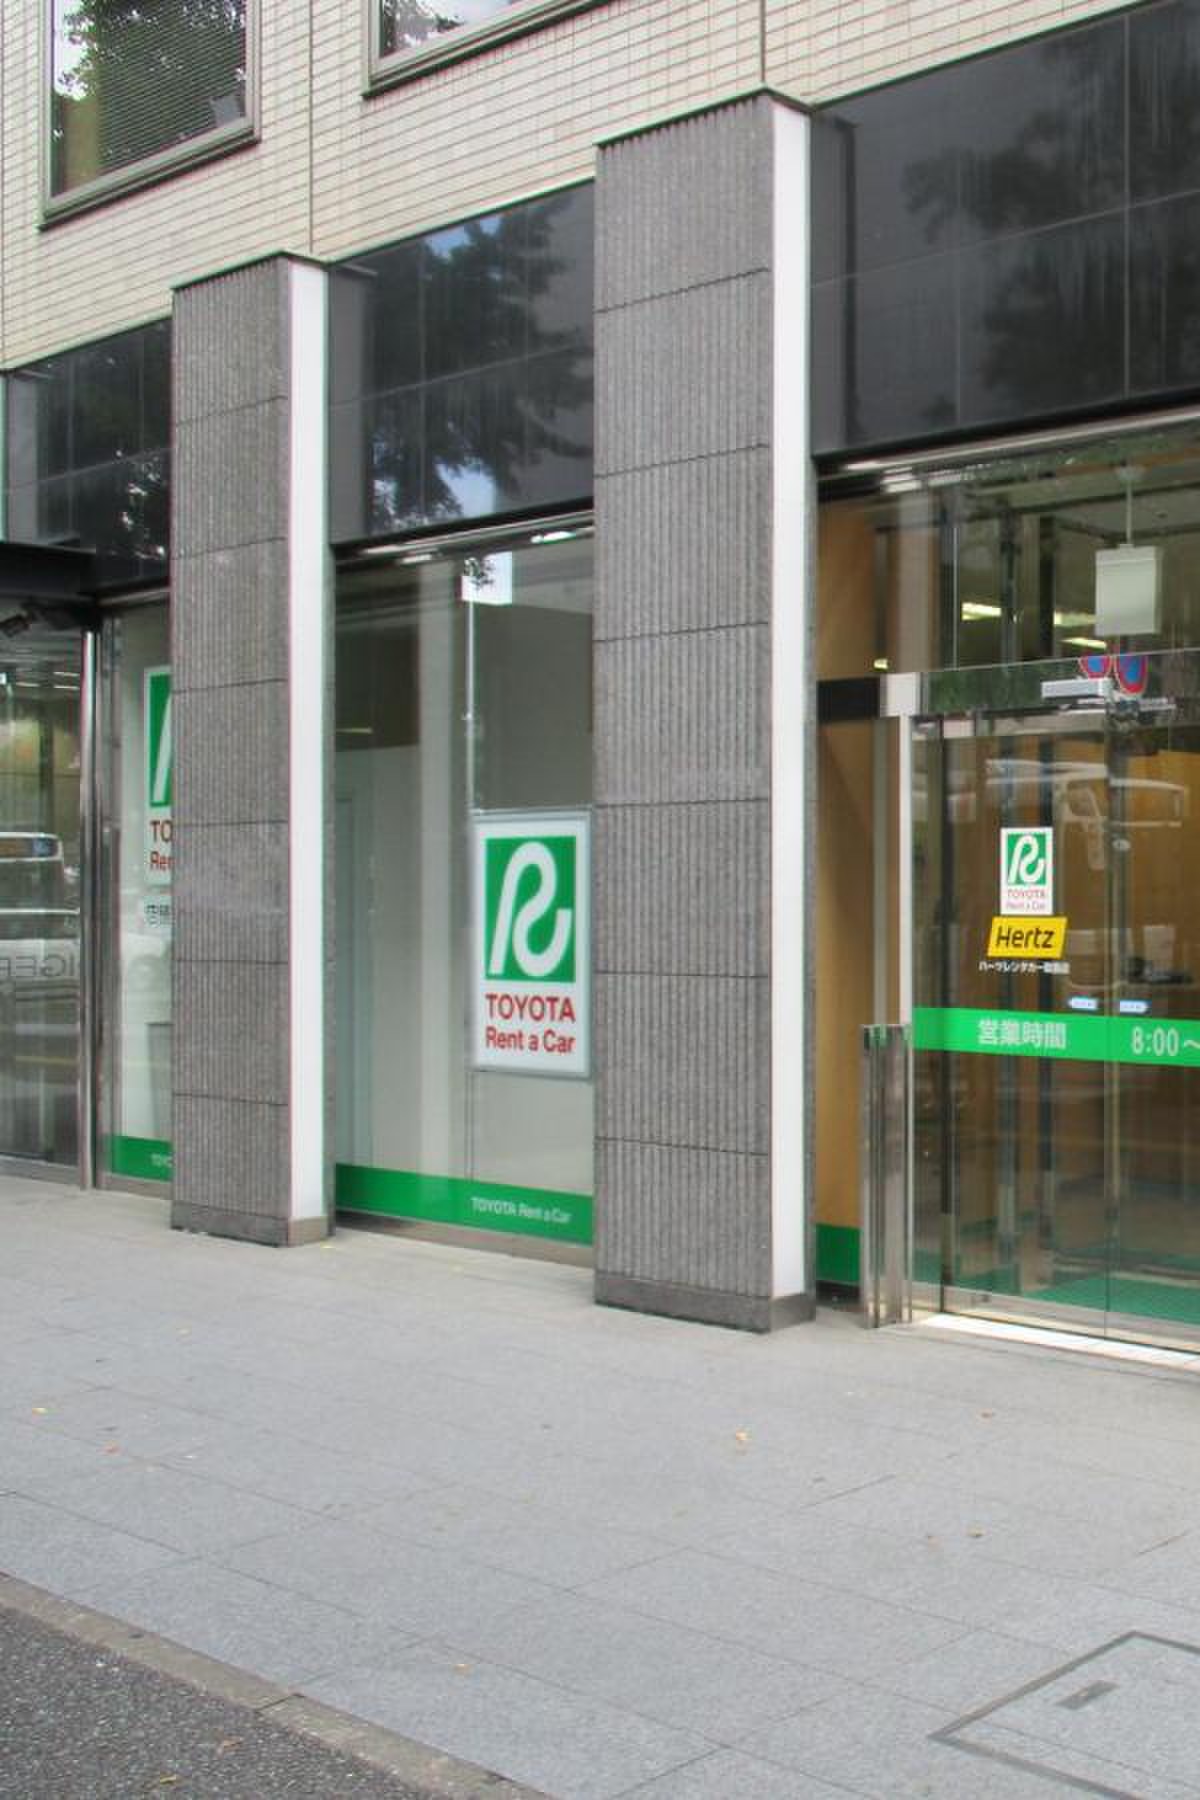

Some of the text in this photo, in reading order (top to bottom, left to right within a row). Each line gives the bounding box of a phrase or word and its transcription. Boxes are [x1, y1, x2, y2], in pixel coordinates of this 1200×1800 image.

[995, 924, 1055, 950] Hertz
[485, 993, 576, 1023] TOYOTA
[485, 1025, 576, 1054] Rent a Car
[978, 1016, 1067, 1050] 営業時間
